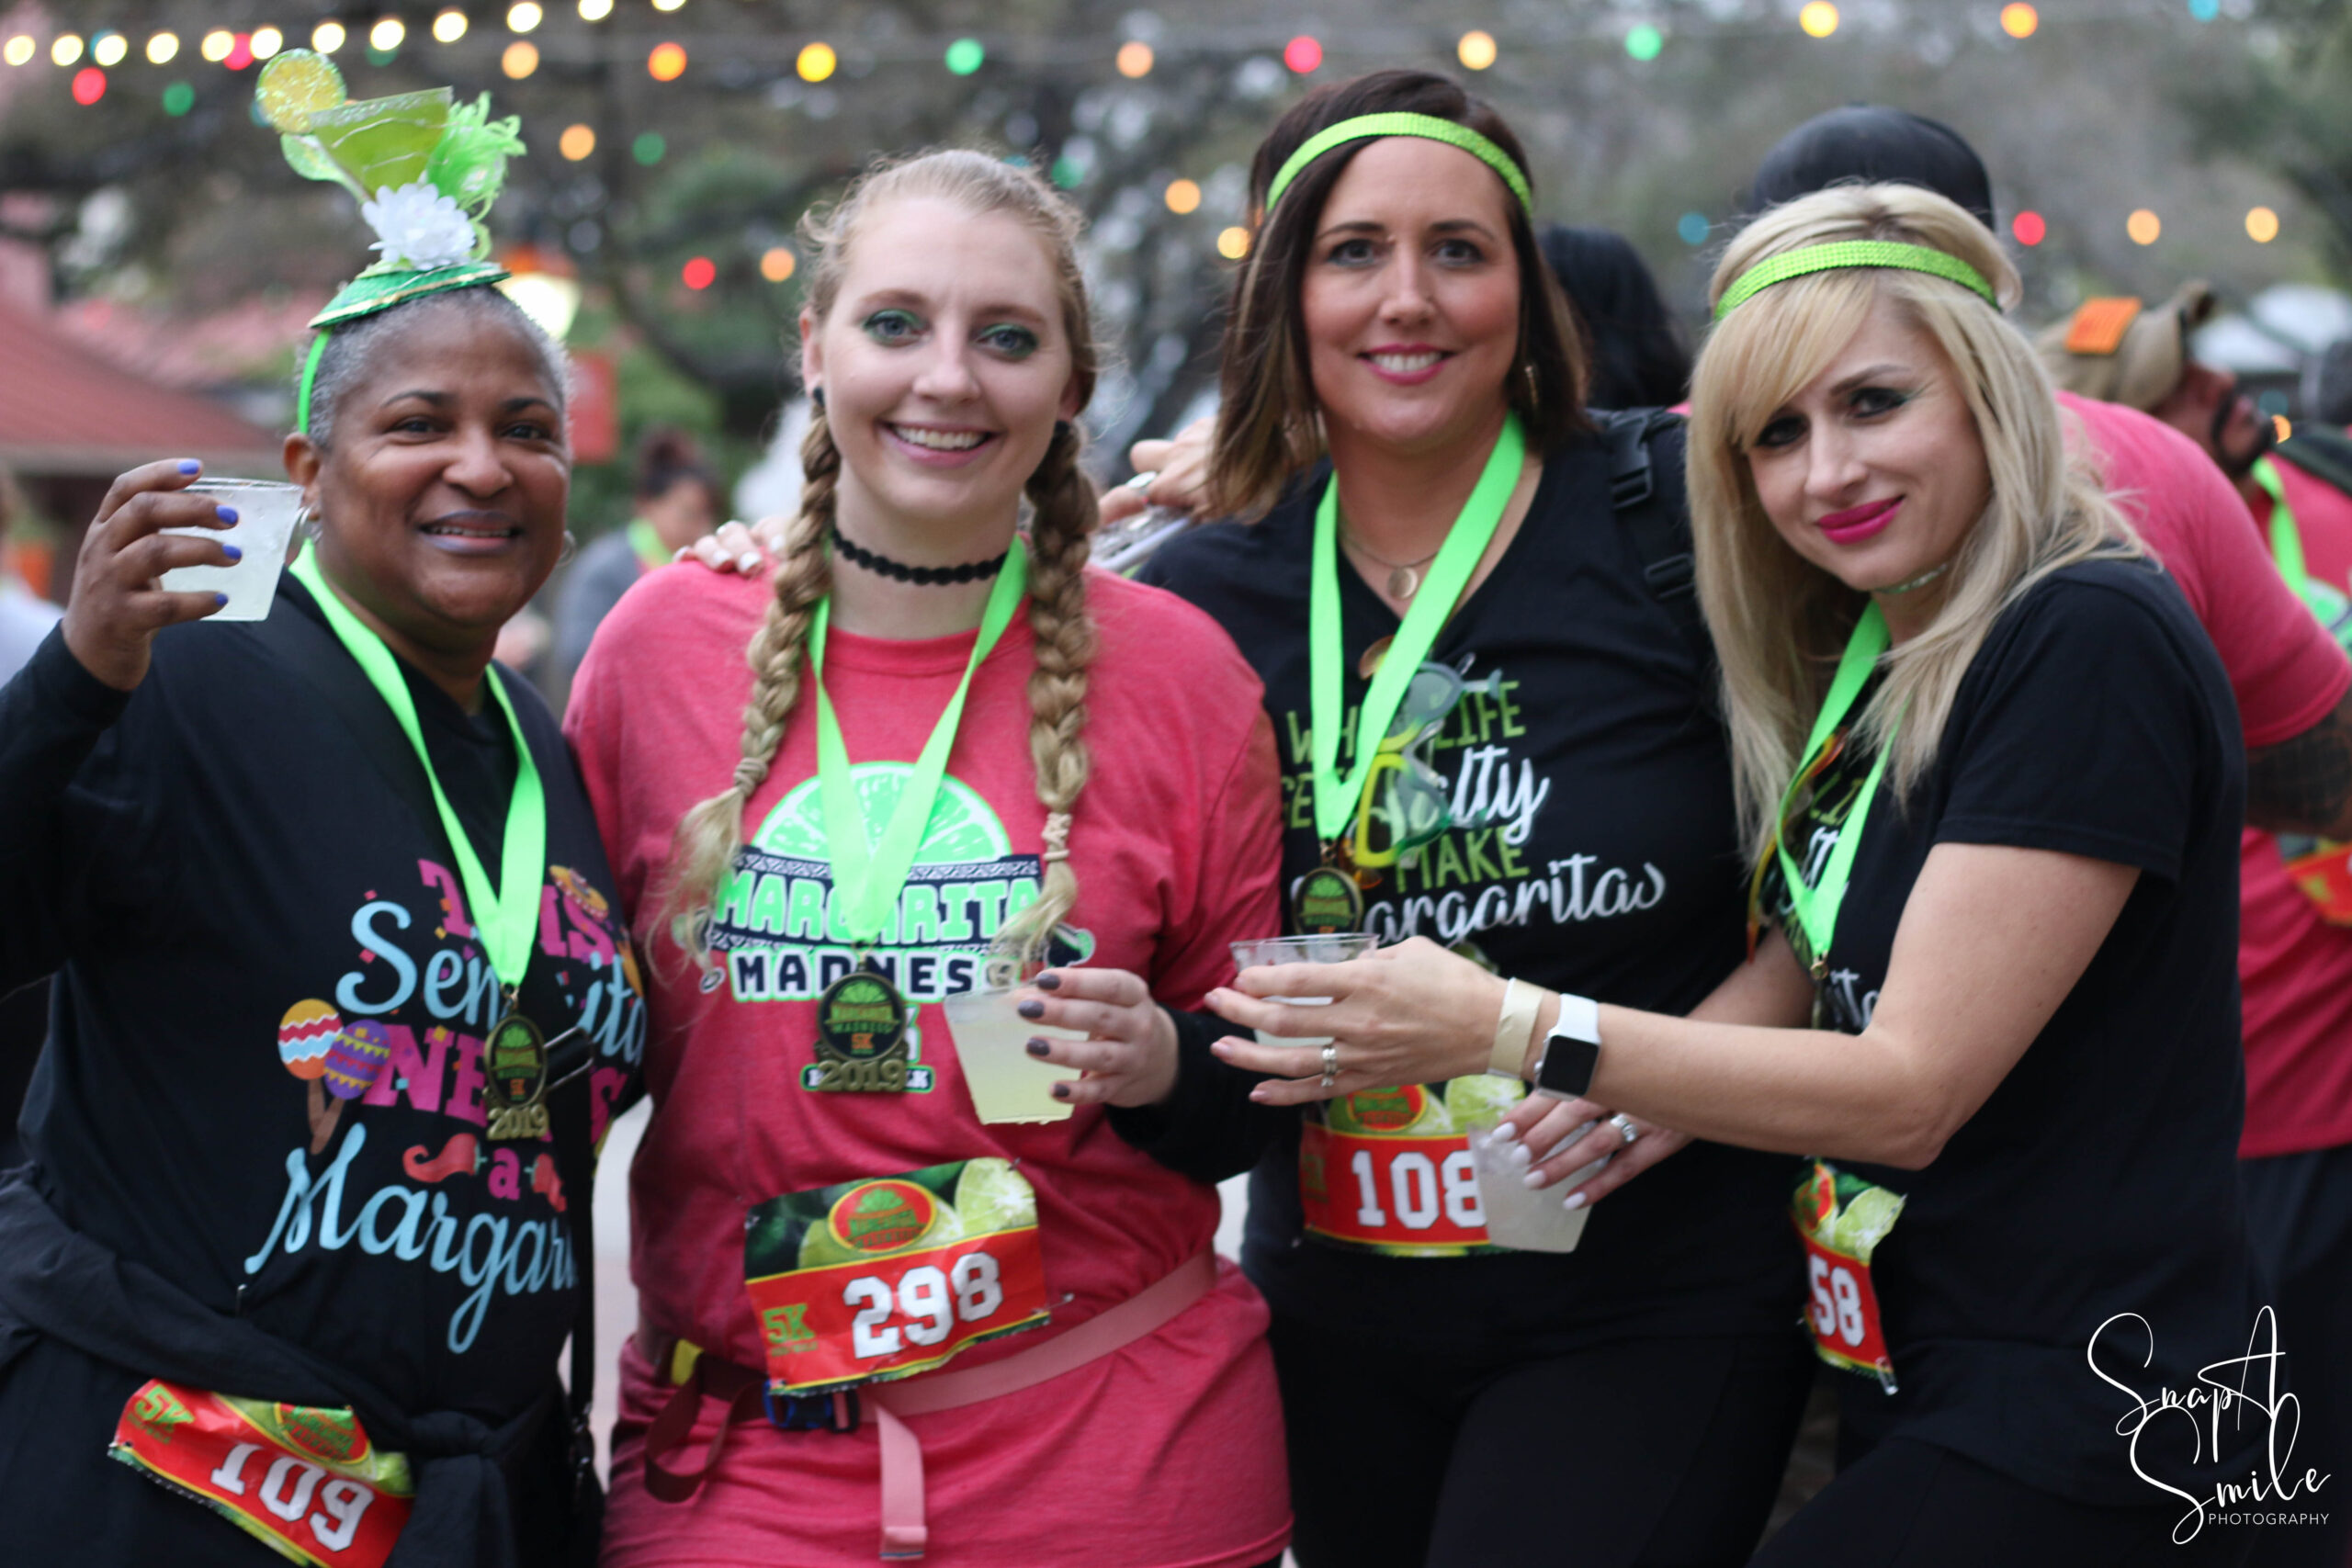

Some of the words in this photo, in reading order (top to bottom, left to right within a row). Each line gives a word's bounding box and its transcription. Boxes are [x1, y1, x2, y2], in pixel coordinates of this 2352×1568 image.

[416, 858, 618, 967] TIS
[1290, 853, 1666, 949] argaritas
[817, 1058, 907, 1091] 2019
[487, 1105, 549, 1141] 2019
[488, 1148, 520, 1200] a
[1351, 1149, 1487, 1230] 108
[762, 1303, 815, 1344] 5K
[842, 1250, 1004, 1360] 298
[210, 1442, 374, 1553] 109
